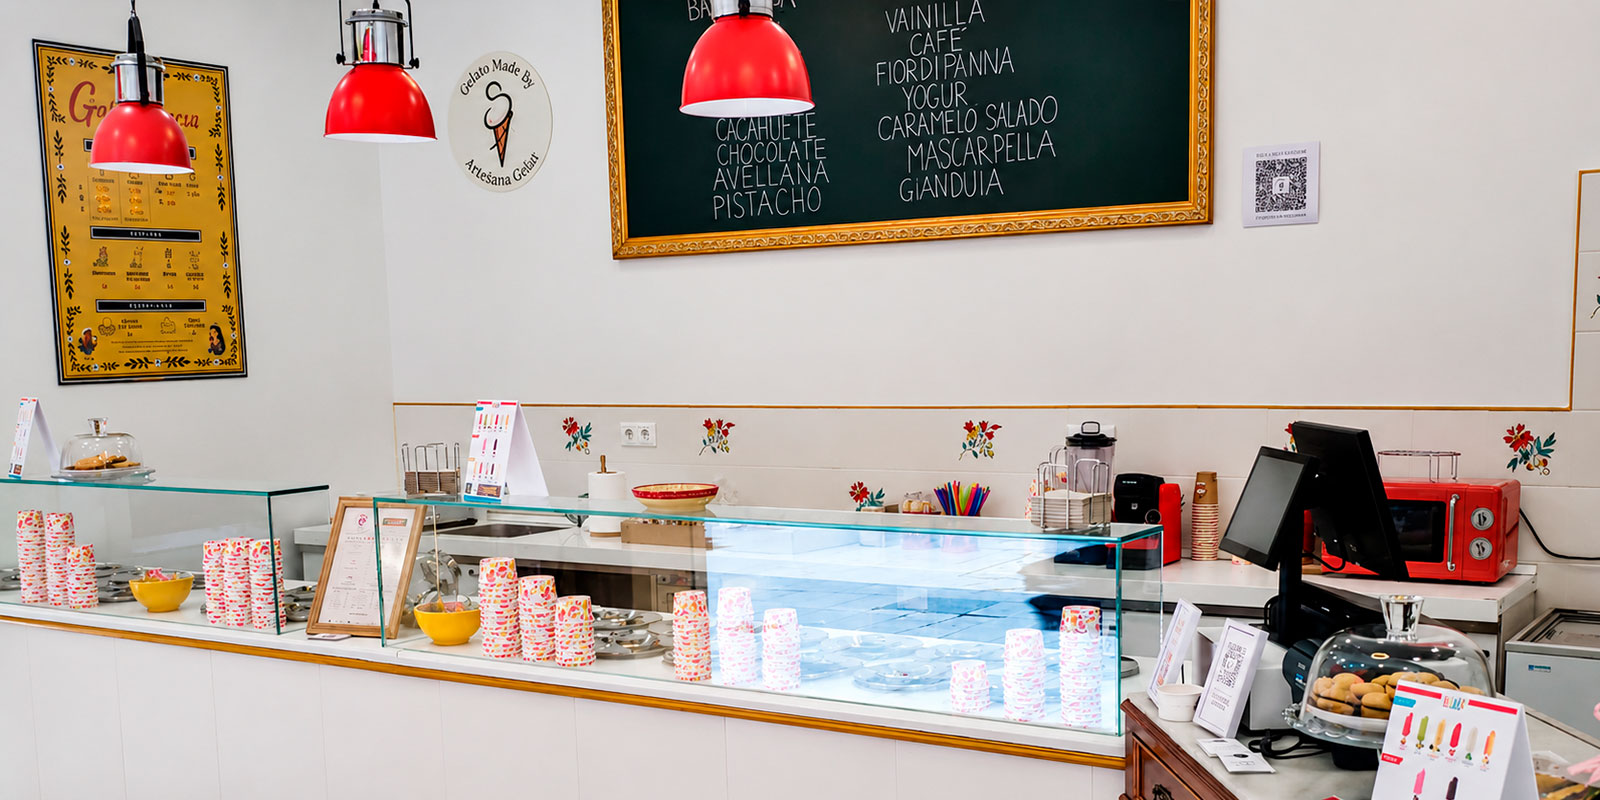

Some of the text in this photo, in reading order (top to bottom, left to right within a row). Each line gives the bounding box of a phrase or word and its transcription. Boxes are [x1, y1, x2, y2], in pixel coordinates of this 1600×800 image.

[885, 0, 986, 33] VAINILLA
[910, 27, 968, 56] CAFÉ
[459, 58, 536, 96] Gelato Made By
[902, 81, 969, 112] YOGUR
[715, 112, 817, 142] CACAHUETE
[985, 95, 1059, 131] SALADO
[717, 138, 827, 166] CHOCOLATE
[713, 160, 830, 191] AVELLANA
[713, 186, 822, 220] PISTACHO
